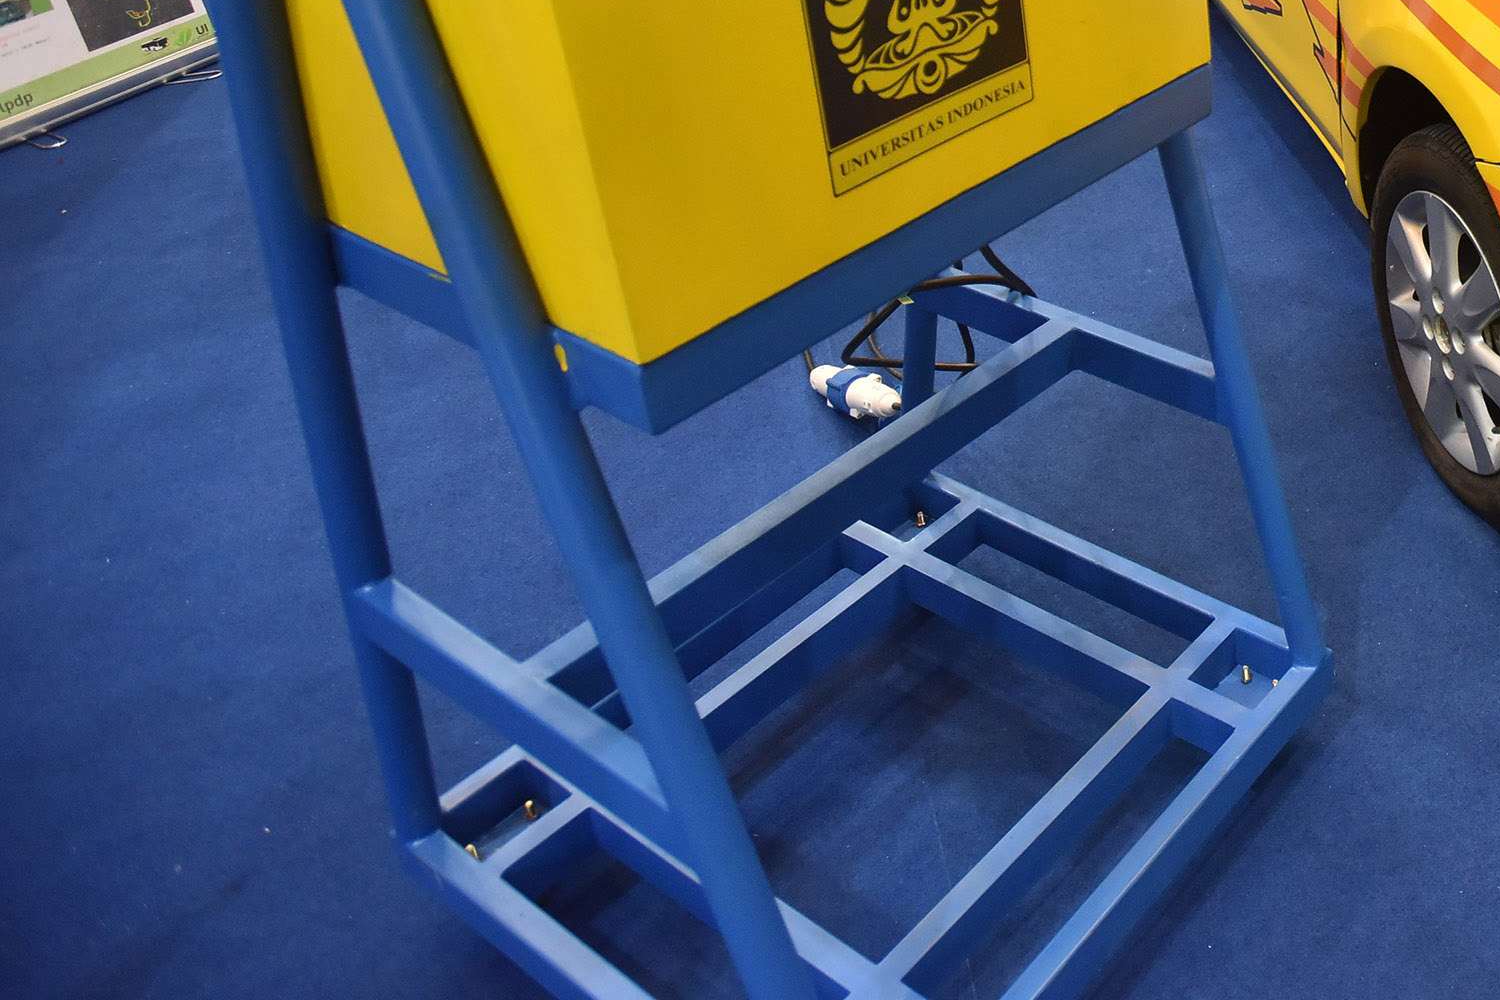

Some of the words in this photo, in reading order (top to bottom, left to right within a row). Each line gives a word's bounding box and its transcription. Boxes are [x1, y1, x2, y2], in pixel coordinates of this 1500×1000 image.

[195, 23, 209, 35] UI
[0, 91, 34, 115] lpdp
[839, 116, 944, 177] UNIVERSITAS
[947, 79, 1026, 125] INDONESIA
